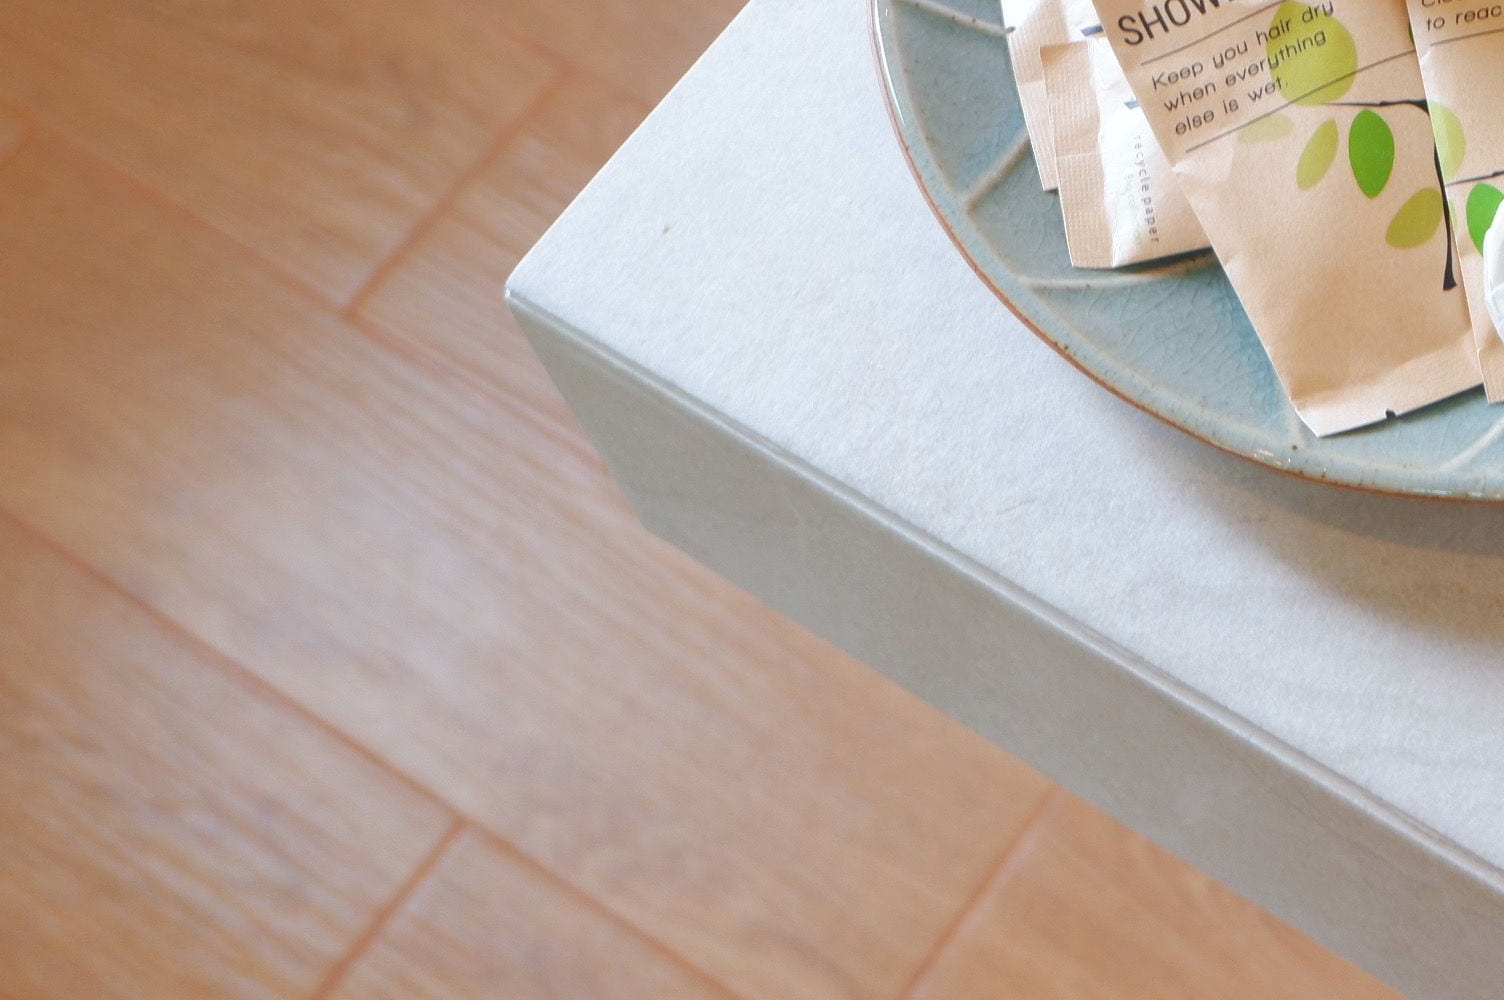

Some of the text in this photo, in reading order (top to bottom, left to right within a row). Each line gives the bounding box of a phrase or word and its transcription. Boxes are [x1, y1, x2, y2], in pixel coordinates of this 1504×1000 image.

[1151, 0, 1335, 91] Keep you hair dry
[1425, 15, 1445, 32] to
[1162, 28, 1327, 113] when everything
[1175, 109, 1215, 136] else
[1223, 99, 1240, 116] is
[1133, 134, 1151, 192] recycle
[1144, 197, 1160, 243] paper
